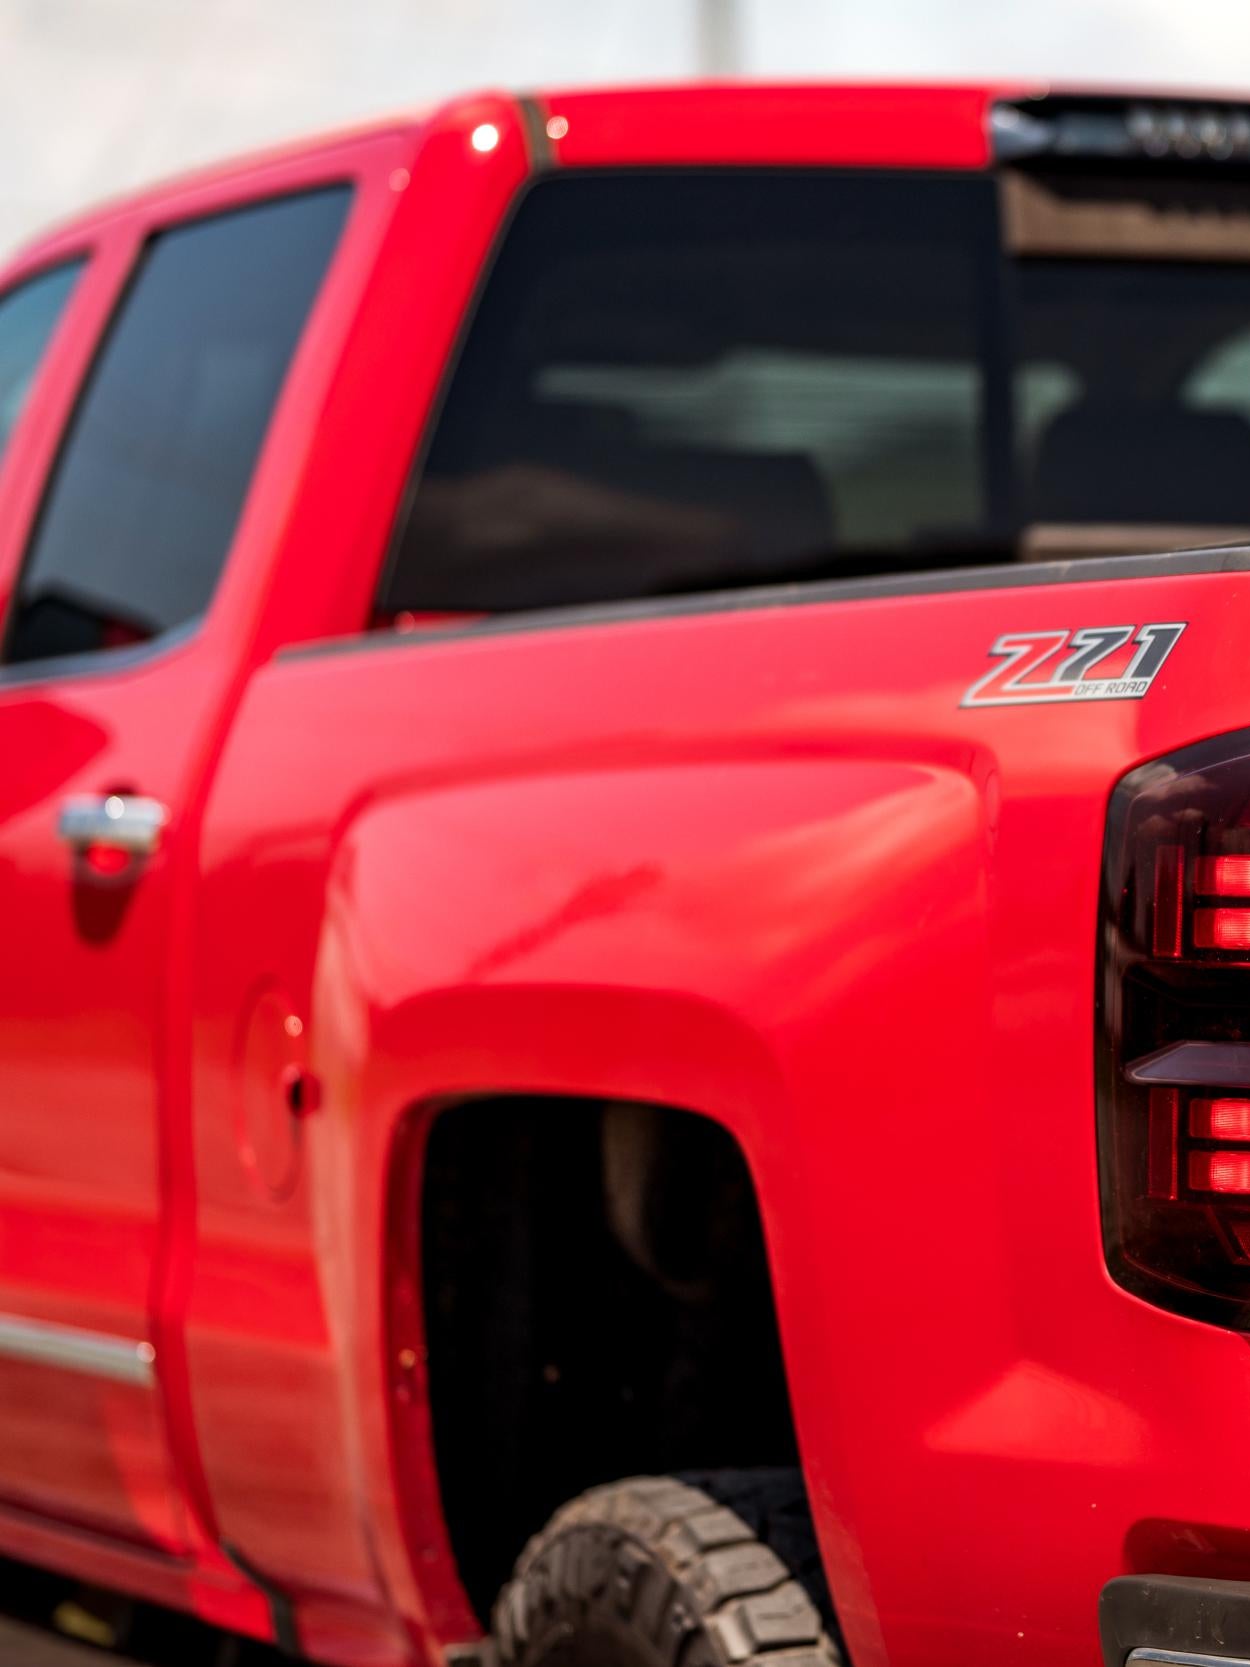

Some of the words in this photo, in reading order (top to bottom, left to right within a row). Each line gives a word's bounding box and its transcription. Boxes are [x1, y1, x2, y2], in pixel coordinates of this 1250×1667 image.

[960, 622, 1188, 708] Z71
[1075, 683, 1103, 696] OFF
[1105, 681, 1148, 694] ROAD
